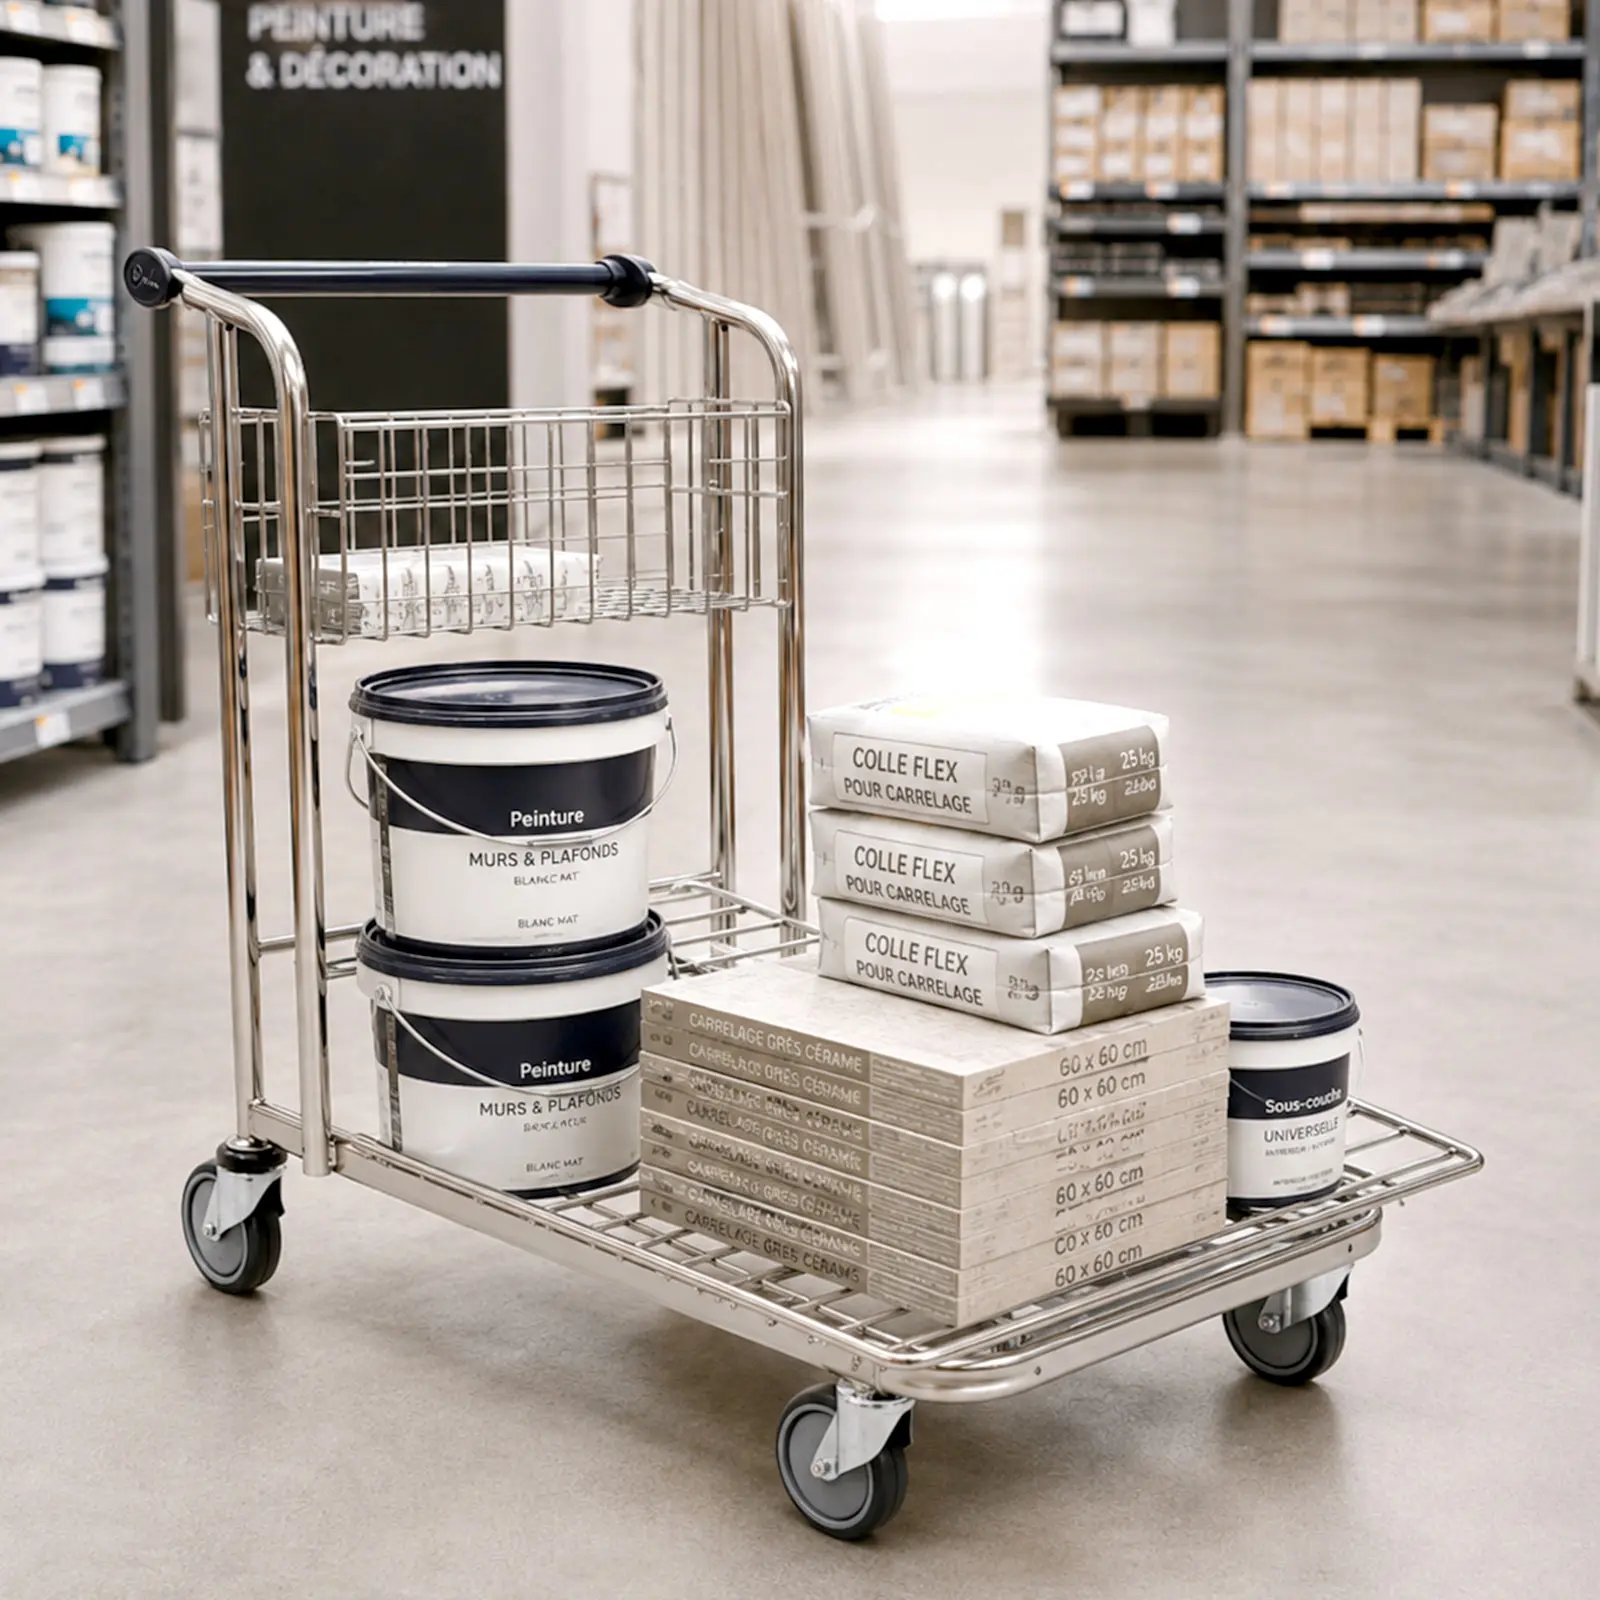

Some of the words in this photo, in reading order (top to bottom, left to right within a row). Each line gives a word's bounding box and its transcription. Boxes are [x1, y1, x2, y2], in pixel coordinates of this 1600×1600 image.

[247, 2, 426, 42] PEINTURE
[245, 52, 274, 89] &
[279, 43, 502, 89] DÉCORATION
[853, 747, 908, 775] COLLE
[913, 756, 958, 783] FLEX
[1120, 749, 1138, 769] 25
[844, 777, 882, 799] POUR
[886, 784, 972, 814] CARRELAGE
[510, 809, 584, 828] Peinture
[469, 852, 518, 867] MURS
[524, 851, 536, 867] &
[541, 842, 618, 865] PLAFONDS
[854, 846, 908, 875] COLLE
[912, 857, 956, 884] FLEX
[1120, 849, 1138, 869] 25
[846, 875, 883, 898] POUR
[886, 883, 971, 915] CARRELAGE
[518, 917, 554, 929] BLANC
[865, 932, 920, 963] COLLE
[924, 946, 968, 976] FLEX
[1145, 946, 1164, 967] 25
[1166, 944, 1183, 964] kg
[856, 960, 894, 984] POUR
[898, 970, 983, 1006] CARRELAGE
[689, 1012, 764, 1047] CARRELAGE
[805, 1043, 863, 1074] CÉRAME
[1060, 1054, 1080, 1076] 60
[1085, 1053, 1095, 1071] x
[1099, 1044, 1118, 1066] 60
[1123, 1039, 1147, 1059] cm
[520, 1058, 592, 1079] Peinture
[480, 1102, 526, 1117] MURS
[532, 1101, 543, 1115] &
[548, 1086, 621, 1112] PLAFONDS
[1058, 1086, 1079, 1109] 60
[1083, 1086, 1093, 1102] x
[1097, 1075, 1117, 1097] 60
[1121, 1071, 1145, 1091] cm
[1264, 1117, 1339, 1143] UNIVERSELLE
[1056, 1182, 1077, 1205] 60
[1081, 1181, 1091, 1197] x
[1095, 1171, 1114, 1192] 60
[1119, 1166, 1144, 1185] cm
[1119, 1212, 1143, 1233] cm
[1055, 1264, 1076, 1287] 60
[1080, 1263, 1089, 1278] x
[1093, 1251, 1114, 1273] 60
[1118, 1244, 1142, 1264] cm
